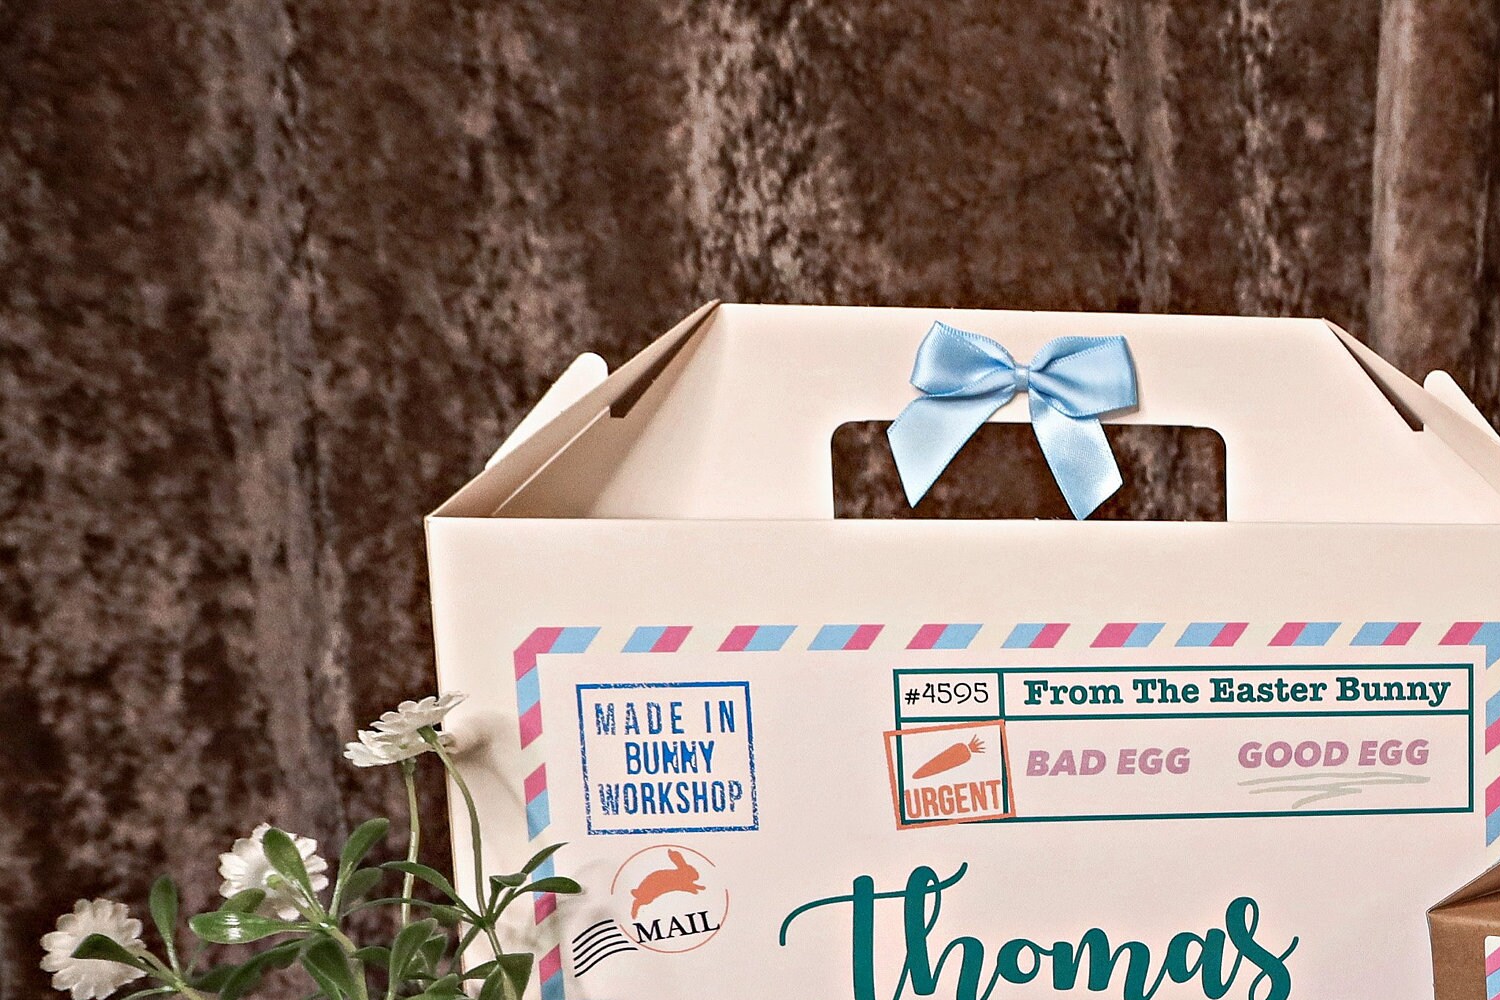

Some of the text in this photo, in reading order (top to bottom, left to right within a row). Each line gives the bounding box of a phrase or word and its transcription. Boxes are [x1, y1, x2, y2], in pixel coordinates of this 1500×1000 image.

[904, 682, 989, 706] #4595
[1024, 673, 1451, 707] From The Easter Bunny
[594, 700, 736, 736] MADE IN
[625, 740, 716, 775] BUNNY
[1025, 747, 1191, 777] BAD EGG
[1237, 738, 1430, 768] GOOD EGG
[597, 780, 743, 815] WORKSHOP
[904, 779, 1003, 819] URGENT
[632, 910, 720, 944] MAIL
